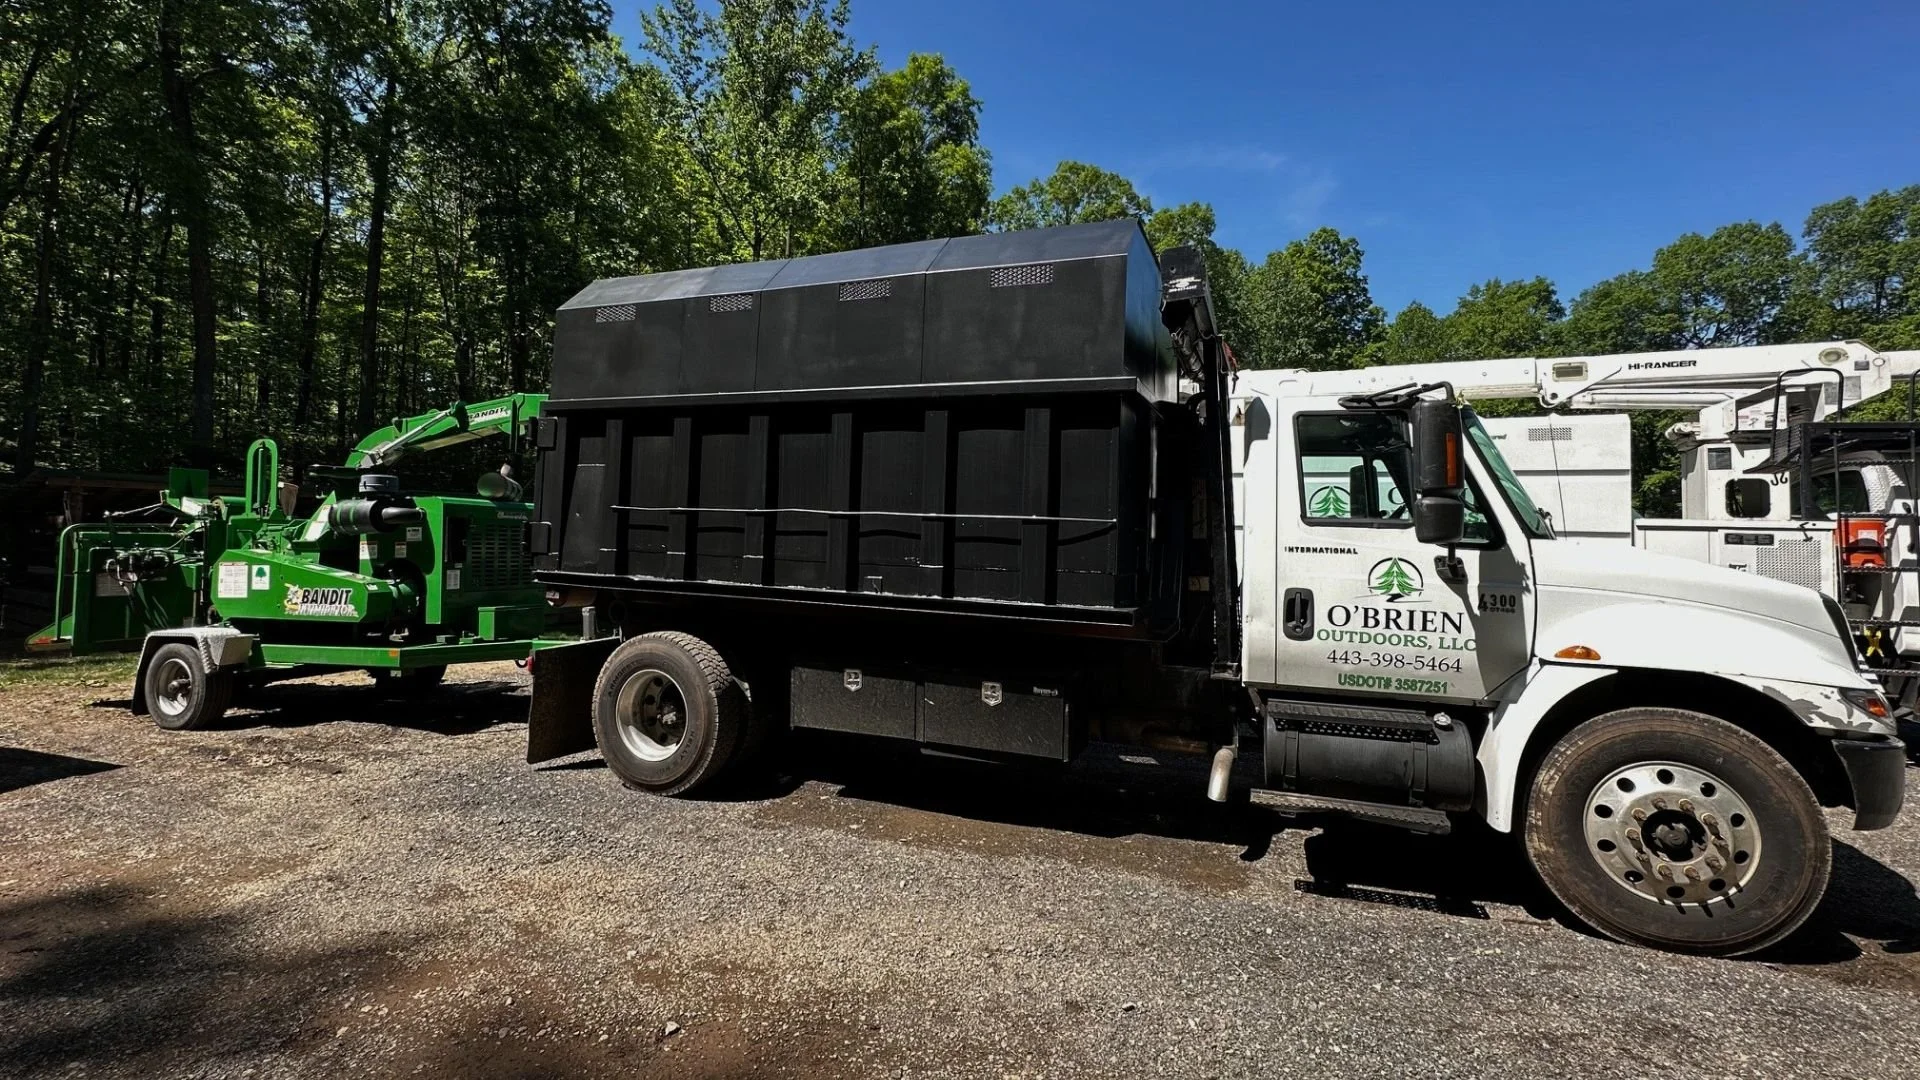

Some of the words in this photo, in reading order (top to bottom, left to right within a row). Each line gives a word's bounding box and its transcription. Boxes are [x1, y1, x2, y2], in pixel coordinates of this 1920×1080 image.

[1628, 360, 1697, 370] HI-RANGER
[1284, 546, 1358, 555] INTERNATIONAL
[301, 589, 352, 605] BANDIT
[1478, 593, 1516, 610] 4300
[1327, 604, 1465, 635] O'BRIEN
[1316, 628, 1433, 650] OUTDOORS,
[1438, 637, 1477, 651] LLC
[1327, 649, 1463, 673] 443-398-5464
[1338, 673, 1393, 690] USDOT#
[1395, 675, 1448, 694] 3587251
